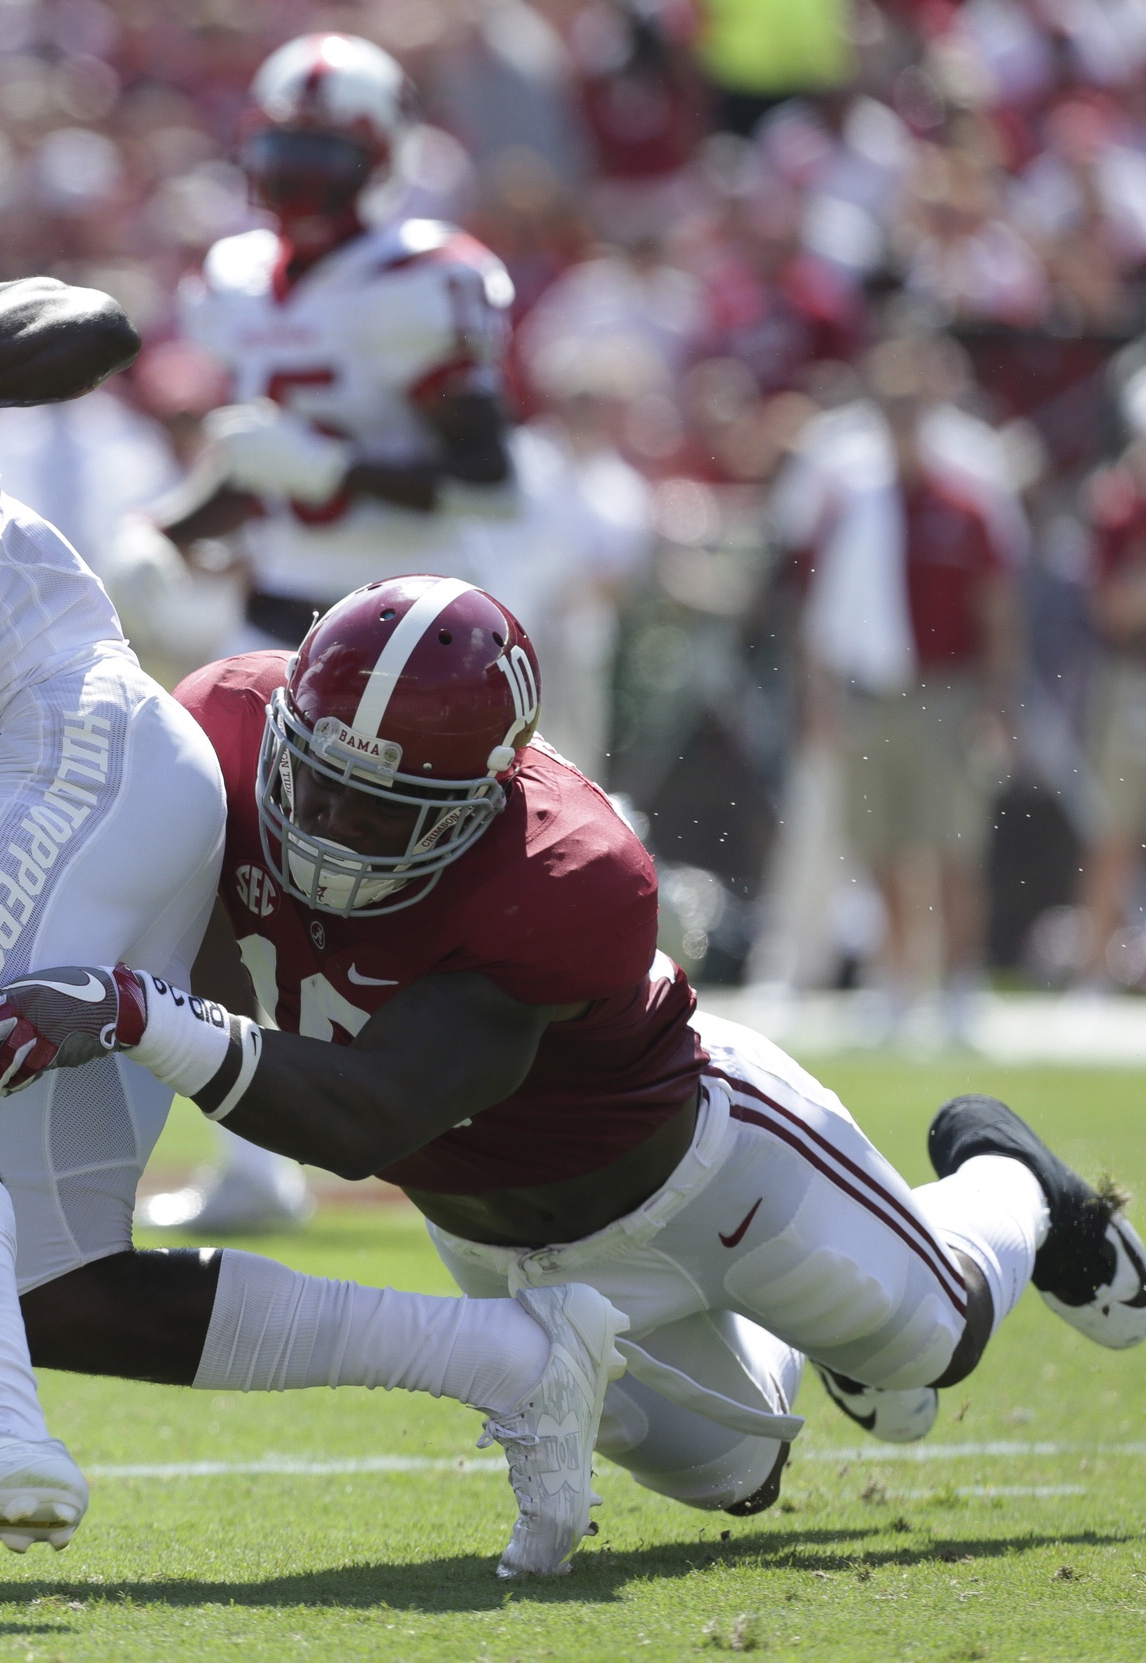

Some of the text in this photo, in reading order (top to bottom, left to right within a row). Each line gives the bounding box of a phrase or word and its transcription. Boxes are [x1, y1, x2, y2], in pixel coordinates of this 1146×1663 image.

[496, 644, 538, 725] 10
[338, 728, 381, 756] BAMA
[421, 812, 460, 848] CRIMSON
[235, 864, 276, 918] SEC
